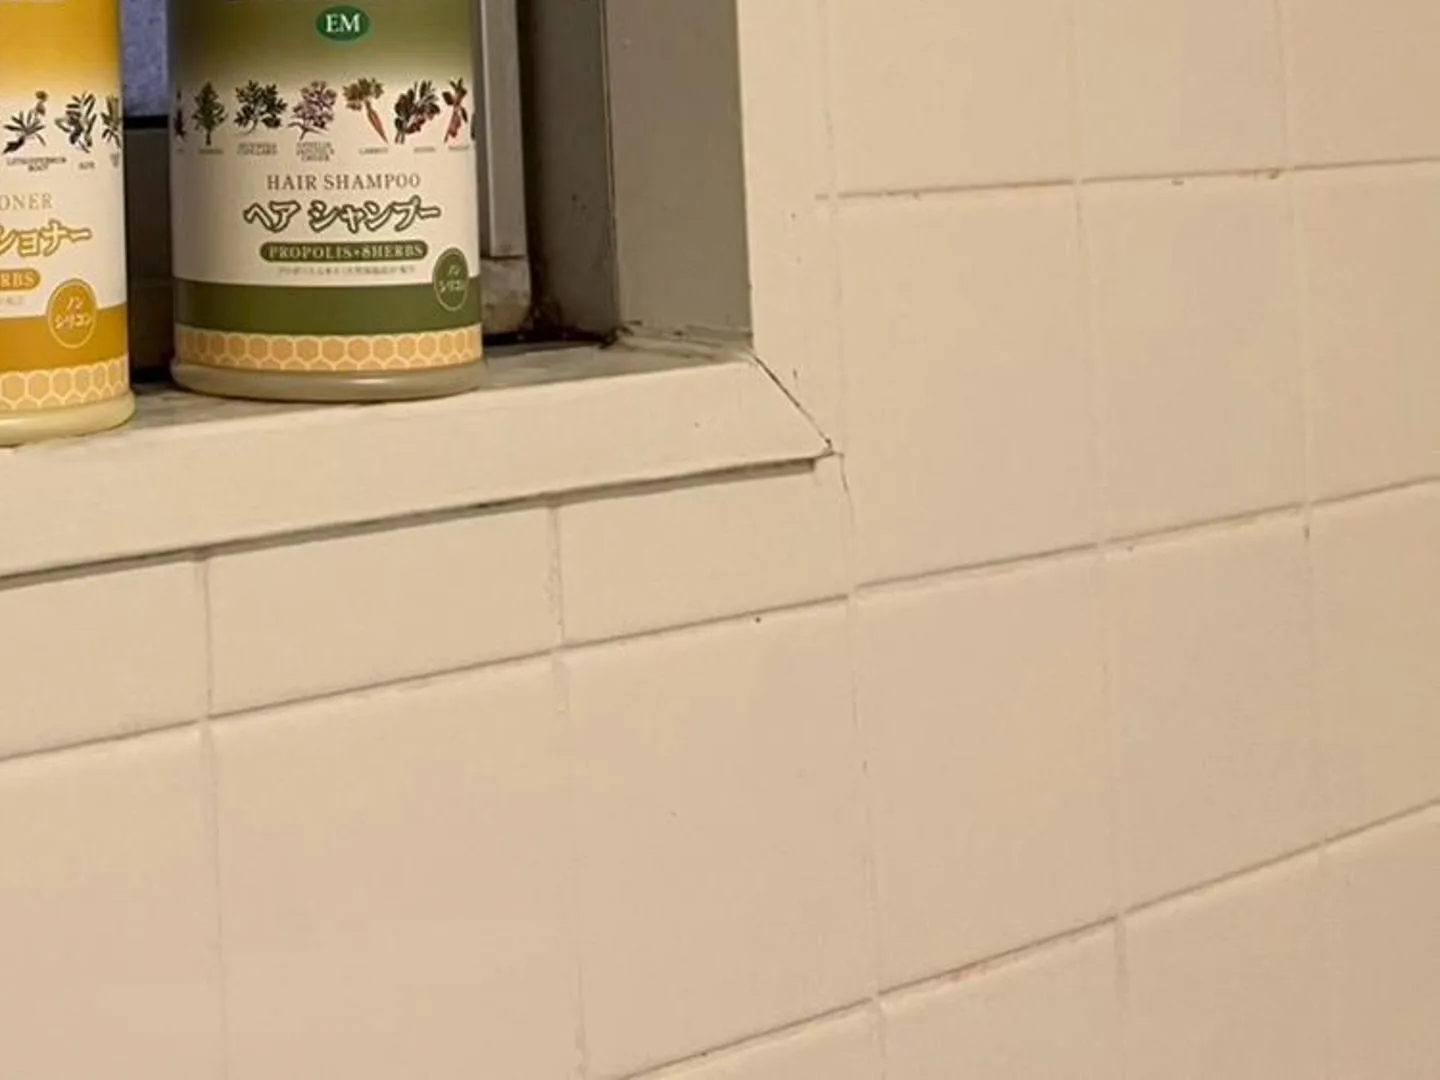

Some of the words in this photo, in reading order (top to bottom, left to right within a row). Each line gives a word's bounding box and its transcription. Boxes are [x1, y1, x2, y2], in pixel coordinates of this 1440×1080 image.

[326, 13, 360, 33] EM
[267, 175, 317, 191] HAIR
[323, 173, 421, 190] SHAMPOO
[244, 200, 301, 233] ヘア
[308, 195, 441, 233] シャンプー
